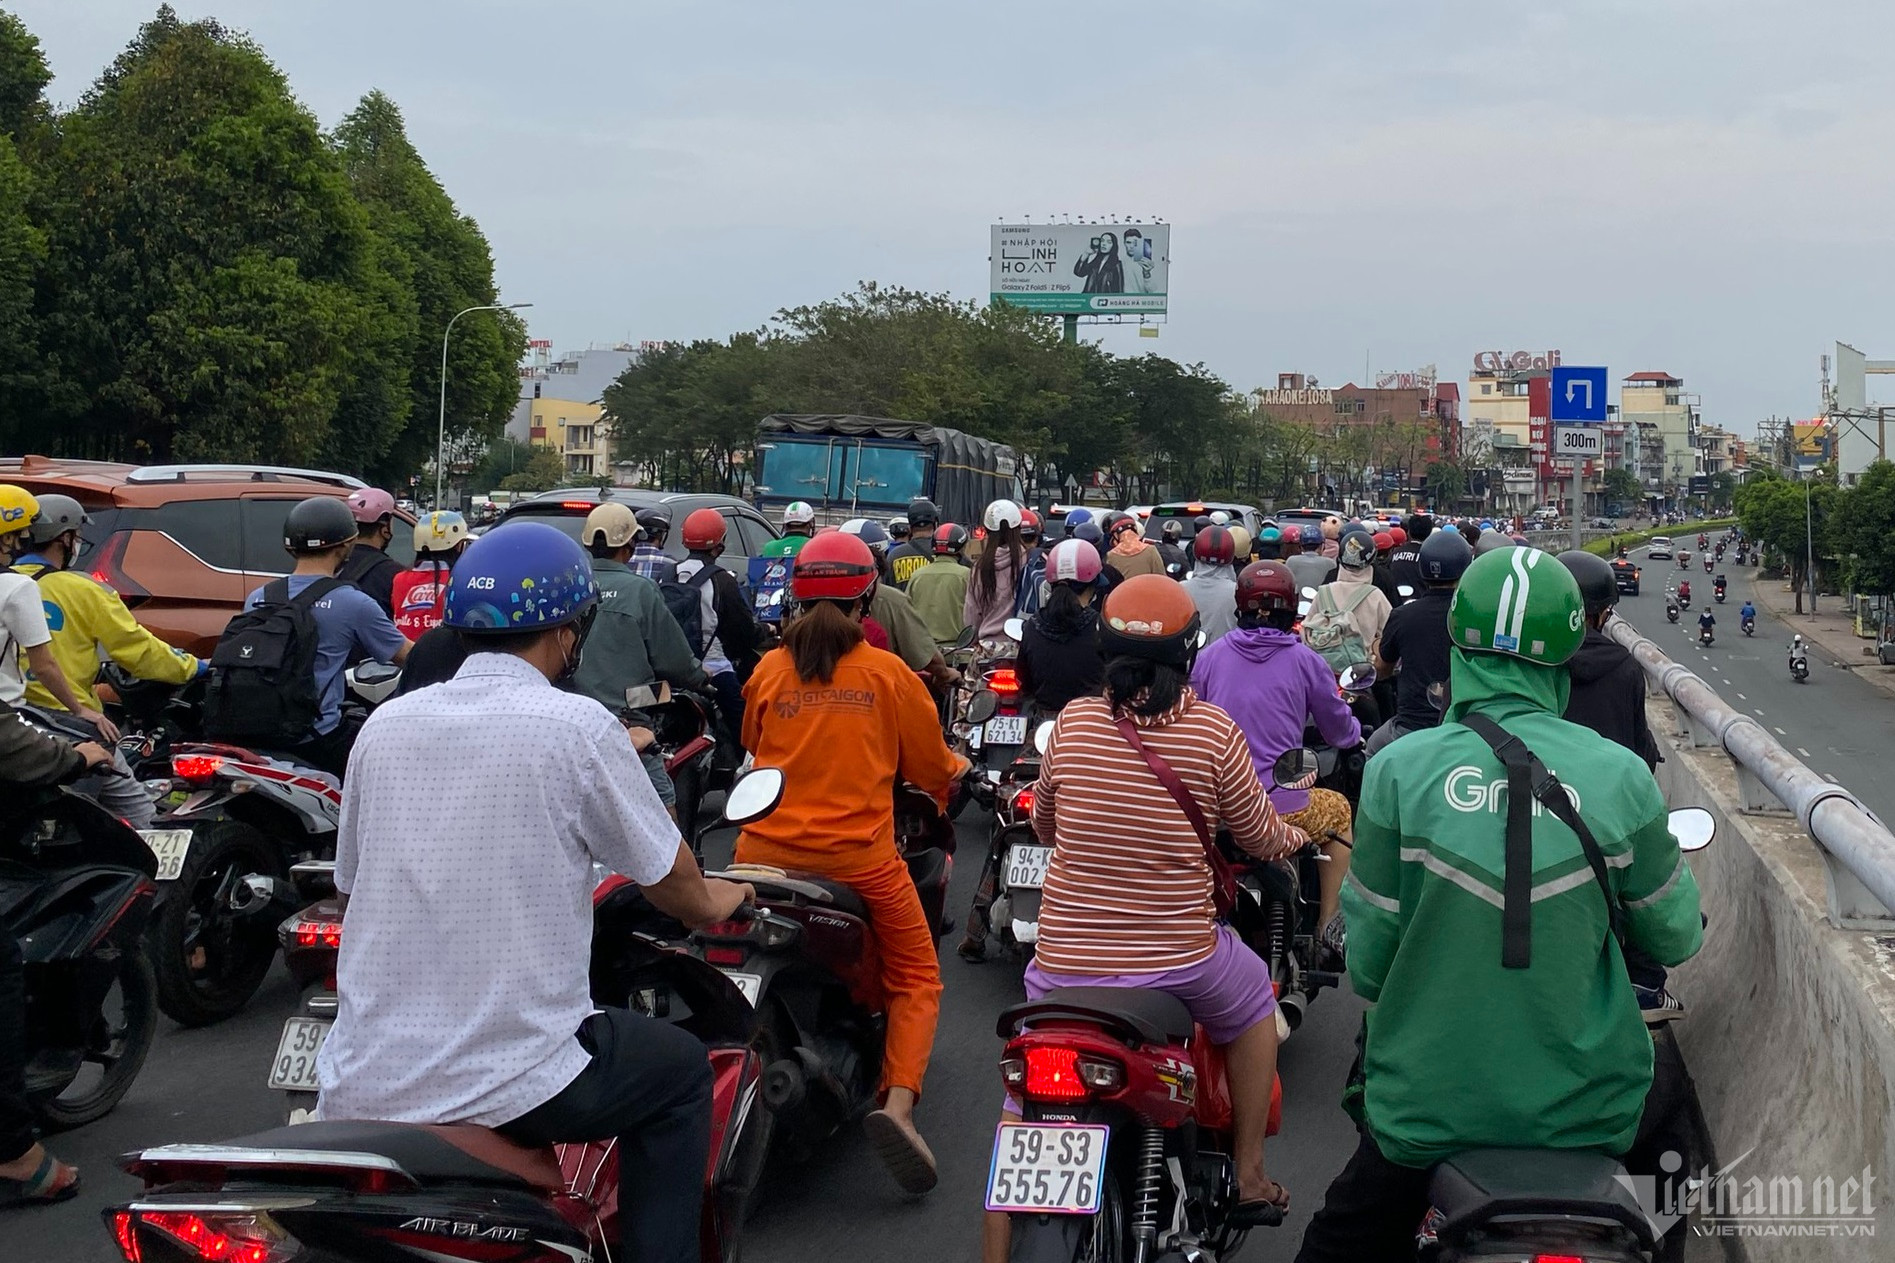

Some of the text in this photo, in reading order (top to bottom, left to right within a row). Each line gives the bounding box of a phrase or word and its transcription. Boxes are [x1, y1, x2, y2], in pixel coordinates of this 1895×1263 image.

[1040, 237, 1057, 247] HỘI
[1002, 248, 1057, 260] LINH
[1001, 261, 1057, 273] HOẠT
[1001, 284, 1024, 292] Galaxy
[1307, 389, 1333, 405] 108A
[1564, 432, 1596, 448] 300m
[467, 576, 496, 589] ACB
[993, 718, 1020, 730] 75-K1
[988, 731, 1023, 743] 621.34
[1018, 848, 1054, 867] 94-K
[1010, 866, 1047, 886] 002.
[809, 913, 850, 929] VISION
[293, 1023, 327, 1052] 59-
[276, 1054, 318, 1084] 934
[1042, 1113, 1077, 1121] HONDA
[1010, 1129, 1091, 1166] 59-S3
[995, 1168, 1093, 1207] 555.76
[400, 1217, 530, 1240] AIR BLADE
